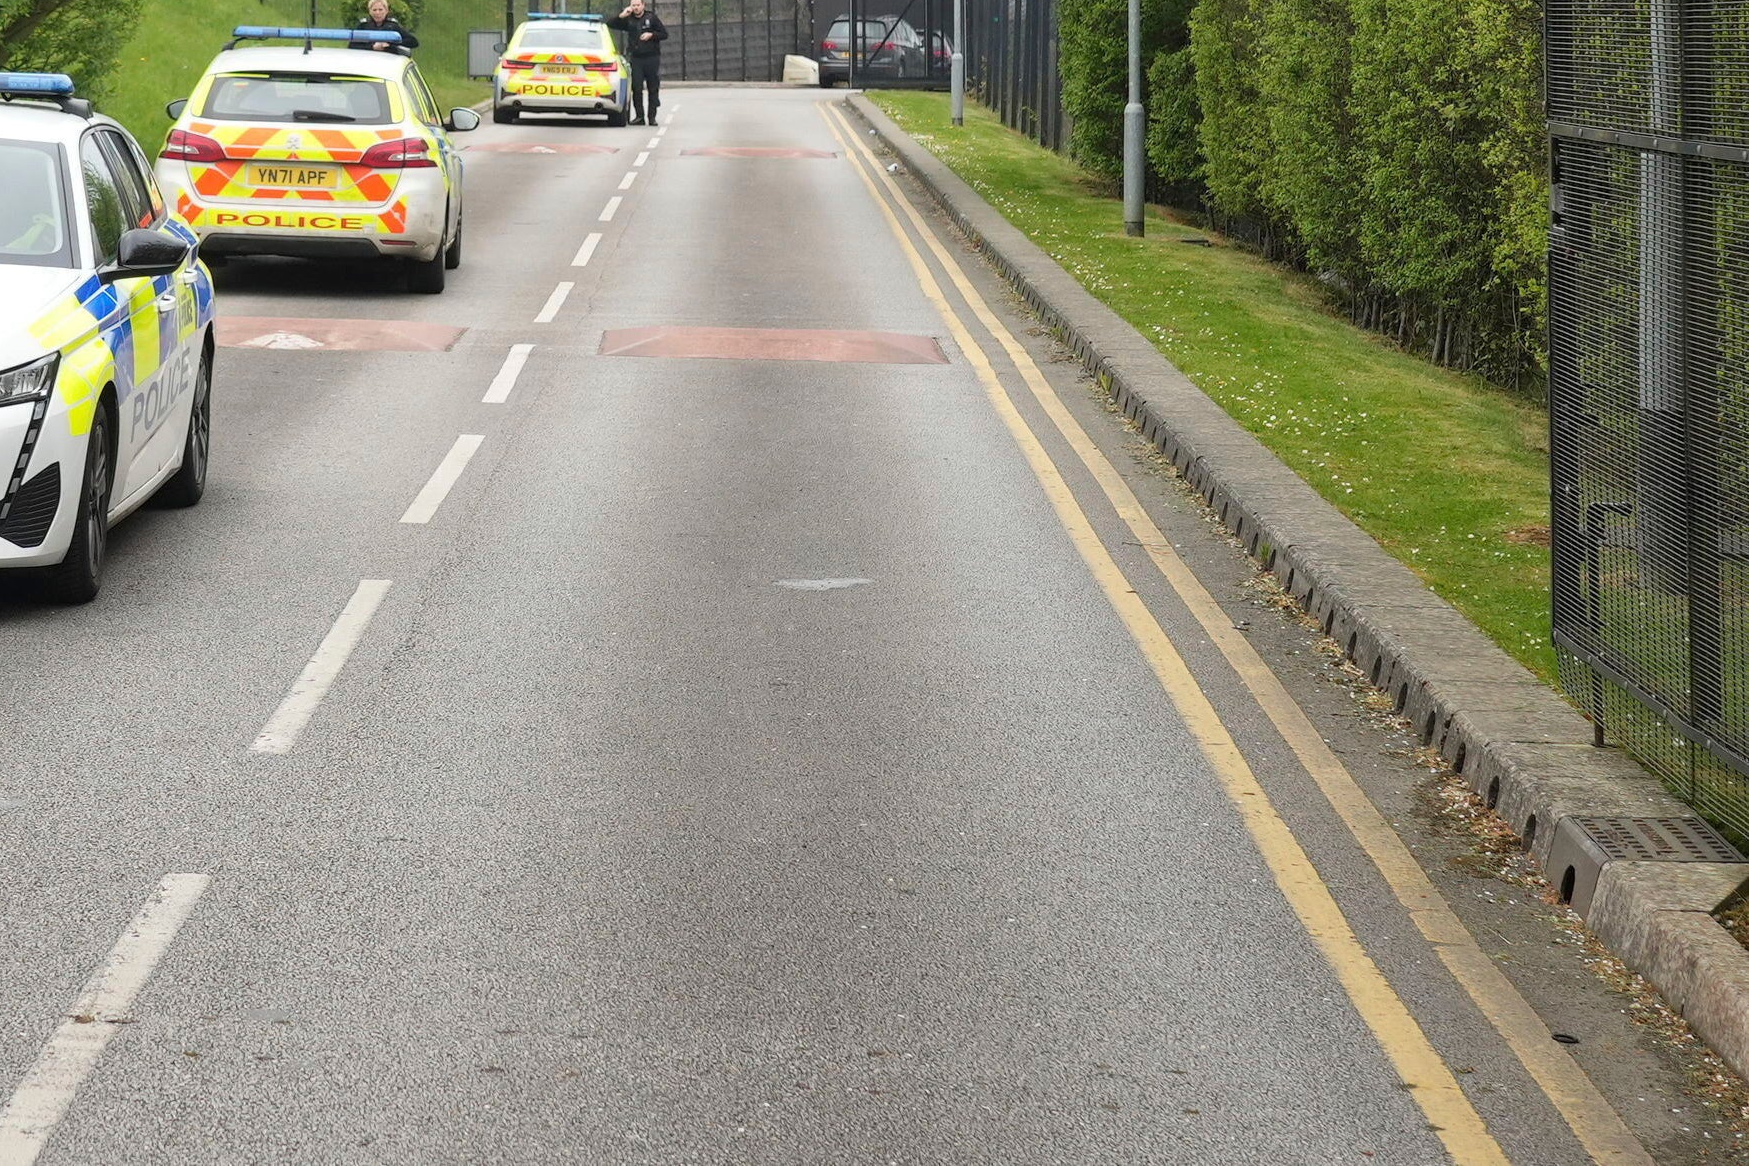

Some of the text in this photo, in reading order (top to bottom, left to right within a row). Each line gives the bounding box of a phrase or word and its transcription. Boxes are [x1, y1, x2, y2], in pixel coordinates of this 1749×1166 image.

[522, 84, 593, 96] POLICE
[258, 168, 327, 185] YN71 APF
[216, 213, 363, 230] POLICE
[130, 346, 191, 444] POLICE
